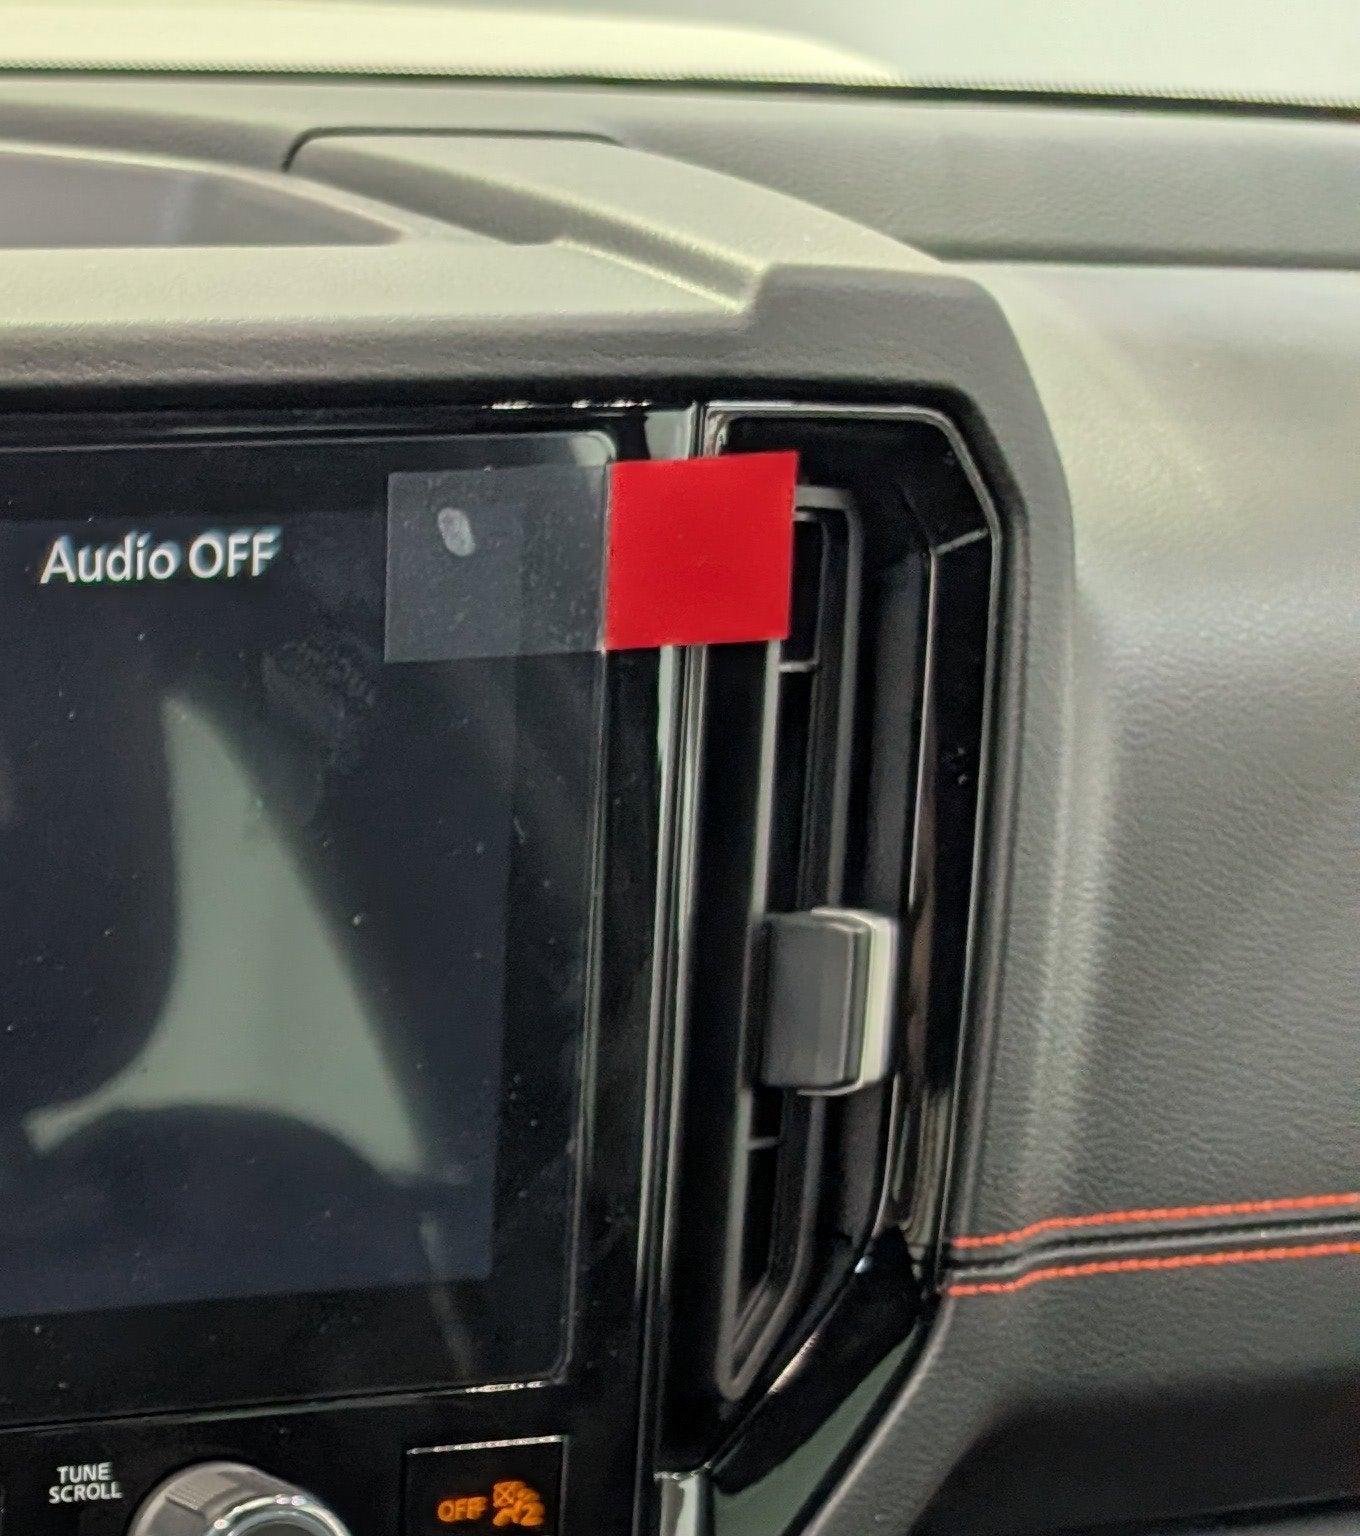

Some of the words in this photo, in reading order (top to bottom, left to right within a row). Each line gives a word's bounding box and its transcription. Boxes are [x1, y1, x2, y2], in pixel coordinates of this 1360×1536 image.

[40, 534, 181, 585] Audio
[188, 529, 280, 579] OFF
[56, 1461, 114, 1485] TUNE
[48, 1480, 123, 1504] SCROLL
[438, 1496, 487, 1523] OFF
